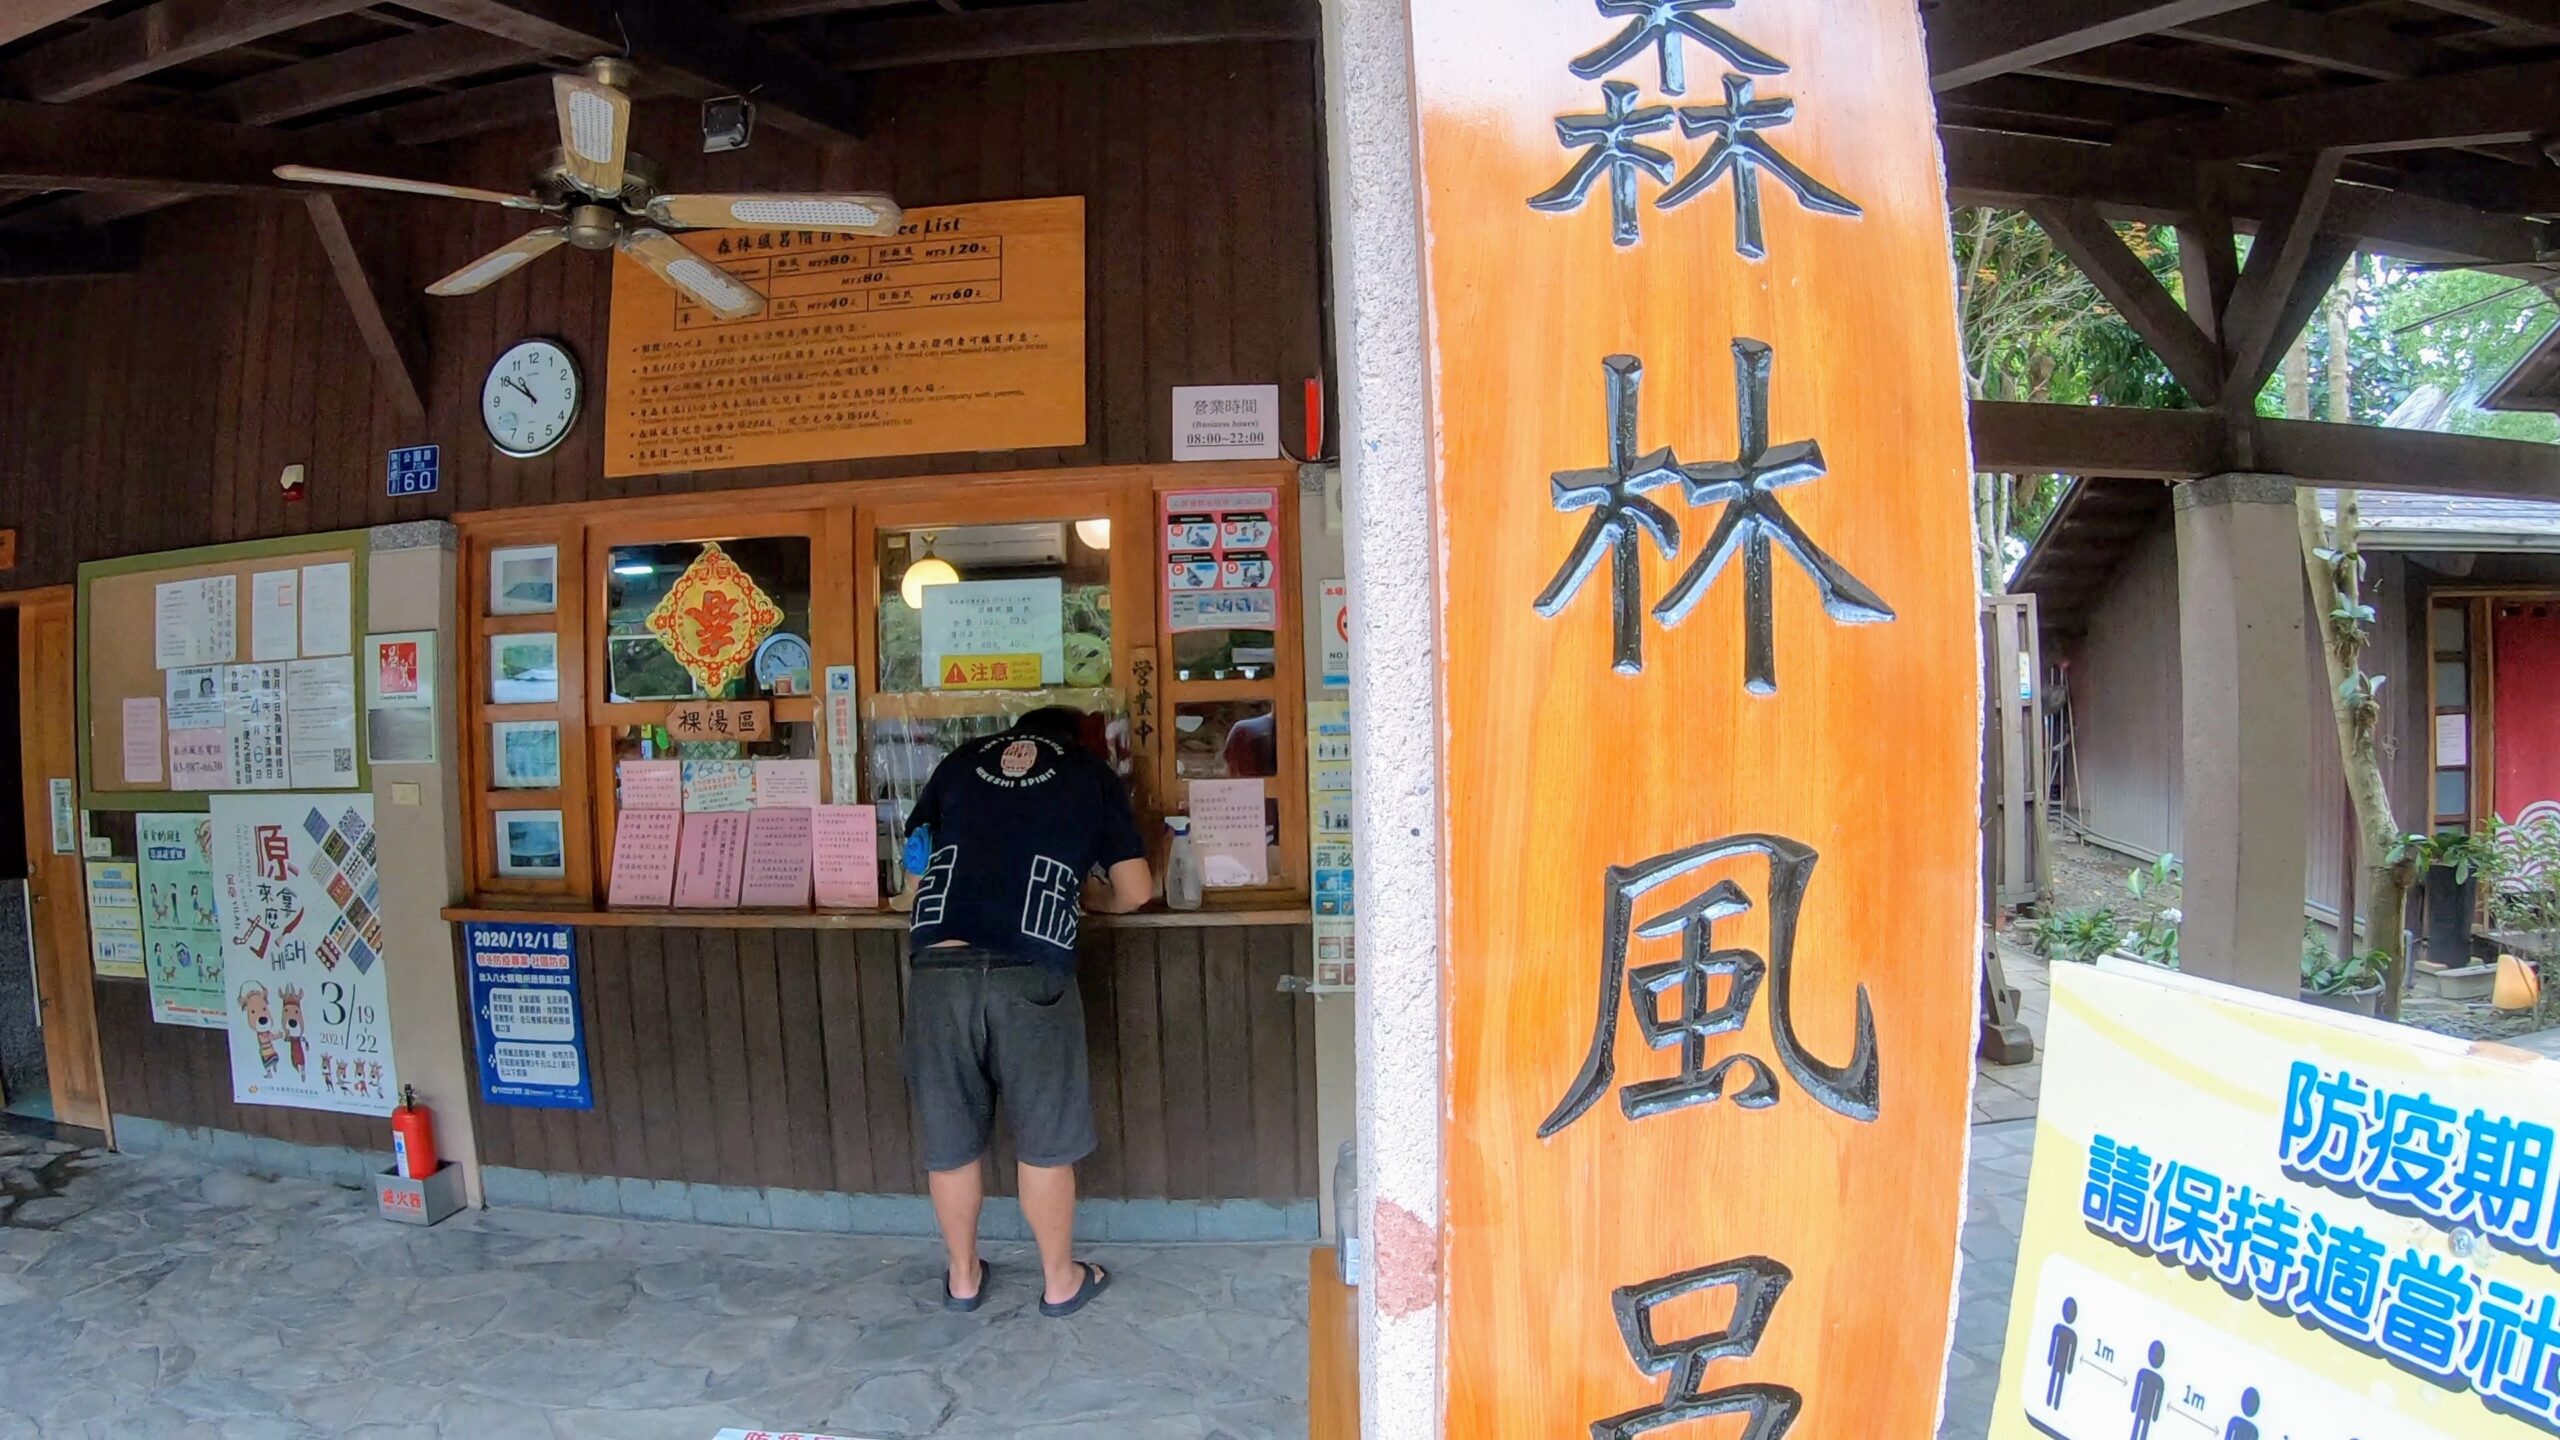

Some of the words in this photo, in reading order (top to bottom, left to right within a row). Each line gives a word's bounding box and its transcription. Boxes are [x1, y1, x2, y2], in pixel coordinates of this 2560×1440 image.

[924, 218, 961, 235] List
[512, 360, 521, 371] 11
[528, 352, 540, 364] 12
[549, 356, 554, 367] 1
[500, 376, 511, 387] 10
[560, 369, 568, 381] 2
[493, 396, 501, 408] 9
[564, 388, 572, 400] 3
[558, 410, 565, 421] 4
[1194, 398, 1257, 416] 營業時間
[510, 428, 517, 440] 7
[527, 431, 534, 444] 6
[545, 424, 553, 437] 5
[1186, 432, 1264, 445] 08:00~22:00
[404, 471, 430, 491] 60
[971, 662, 1008, 681] 注意
[1132, 659, 1153, 747] 營業中
[678, 709, 755, 735] 裸湯區
[1524, 0, 1896, 1440] 森林風呂
[1020, 768, 1056, 787] SPIRIT
[254, 824, 300, 881] 原
[474, 931, 549, 949] 2020/12/1
[356, 1004, 375, 1025] 19
[320, 1031, 344, 1046] 2021
[356, 1034, 379, 1053] 22
[2279, 1060, 2560, 1245] 防疫期
[2083, 1134, 2560, 1412] 請保持適當社
[2094, 1338, 2115, 1363] 1m
[2182, 1385, 2206, 1411] 1m
